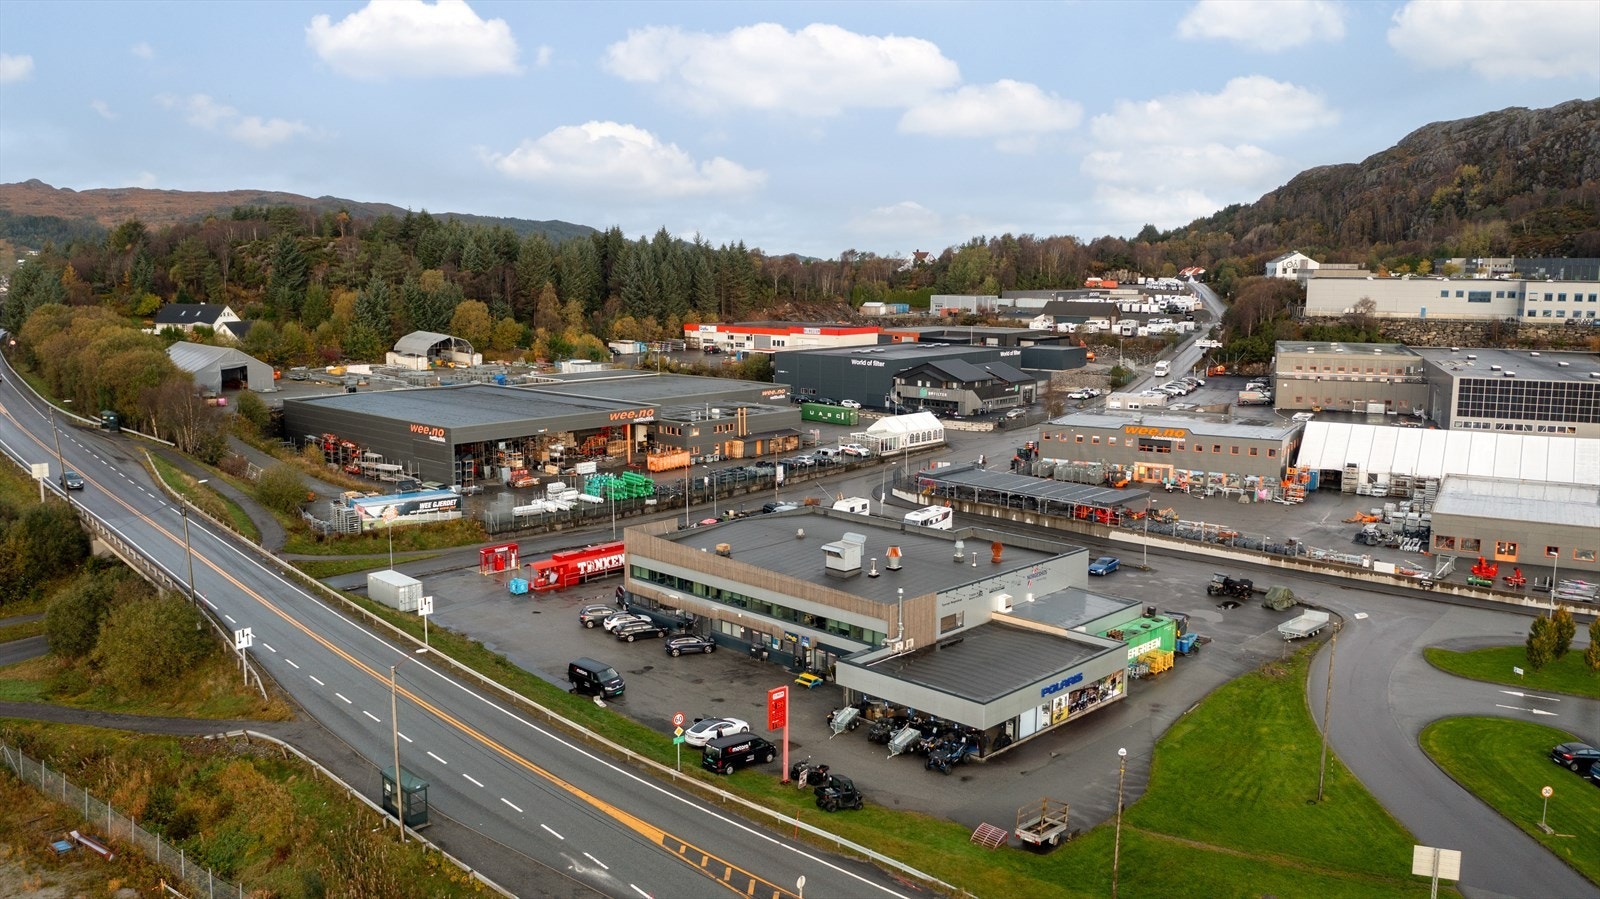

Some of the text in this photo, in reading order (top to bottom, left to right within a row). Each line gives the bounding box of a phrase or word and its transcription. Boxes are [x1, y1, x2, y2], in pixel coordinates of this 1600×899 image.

[762, 388, 786, 396] wee.no
[609, 408, 655, 421] wee.no
[410, 423, 445, 437] wee.no
[1125, 426, 1186, 438] wee.no
[419, 502, 432, 510] WEE
[433, 499, 458, 508] GJERDET
[1041, 672, 1084, 698] POLARIS
